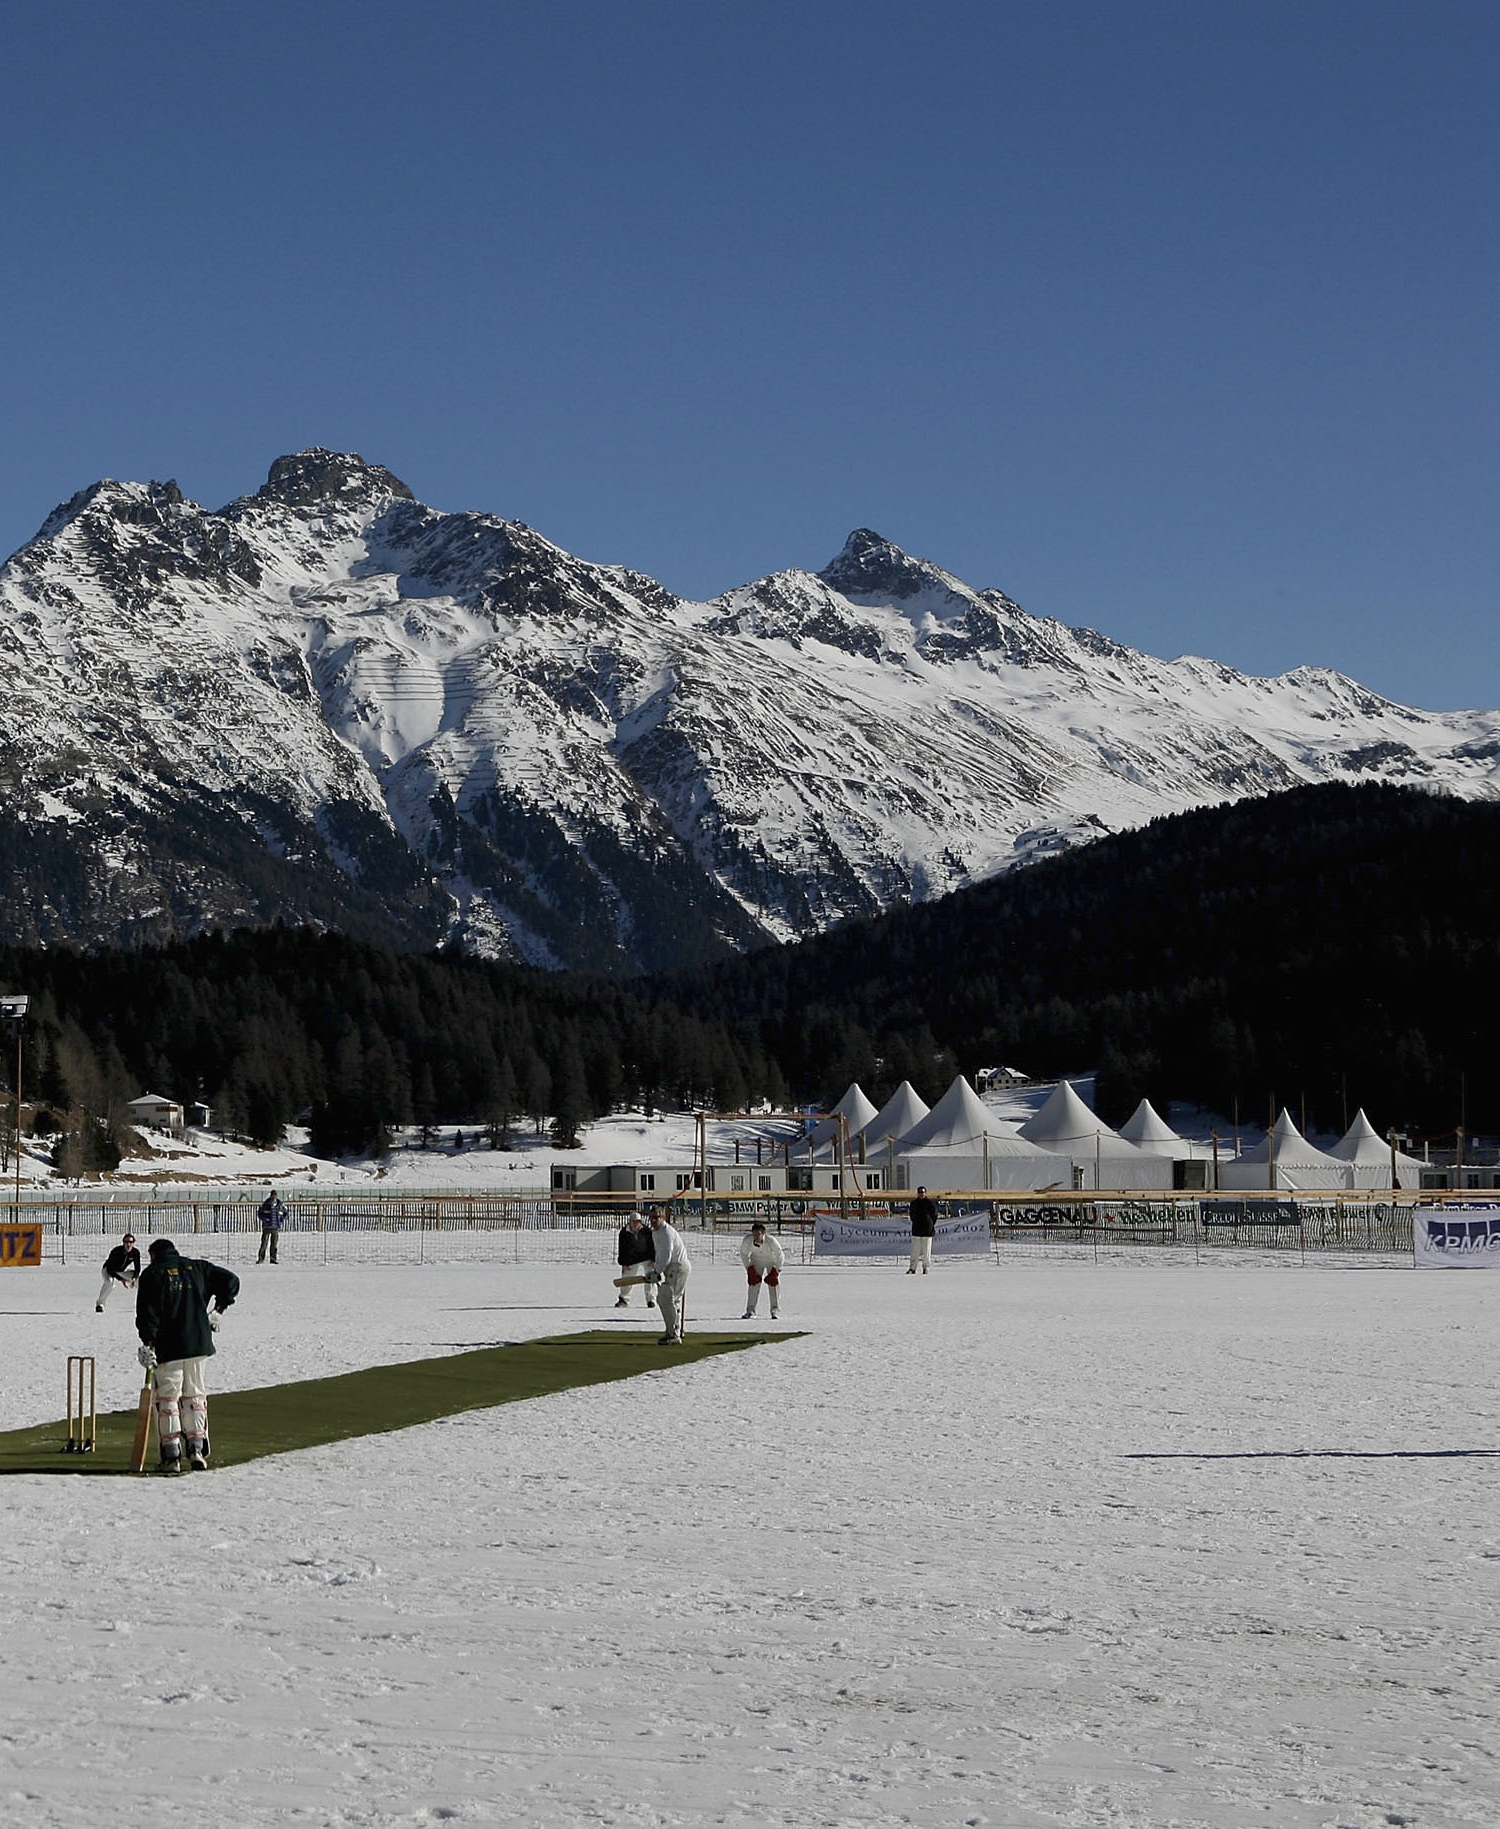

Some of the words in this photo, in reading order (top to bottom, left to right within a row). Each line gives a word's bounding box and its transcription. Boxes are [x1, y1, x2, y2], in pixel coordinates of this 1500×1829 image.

[728, 1202, 755, 1213] BMW
[757, 1202, 789, 1213] Power
[1000, 1207, 1097, 1224] GAGGENAU
[1202, 1210, 1240, 1223] CREDIT
[1245, 1209, 1278, 1222] SUISSE
[840, 1226, 888, 1238] Lyceum
[954, 1224, 985, 1233] Zuoz
[1424, 1232, 1500, 1254] KPMG
